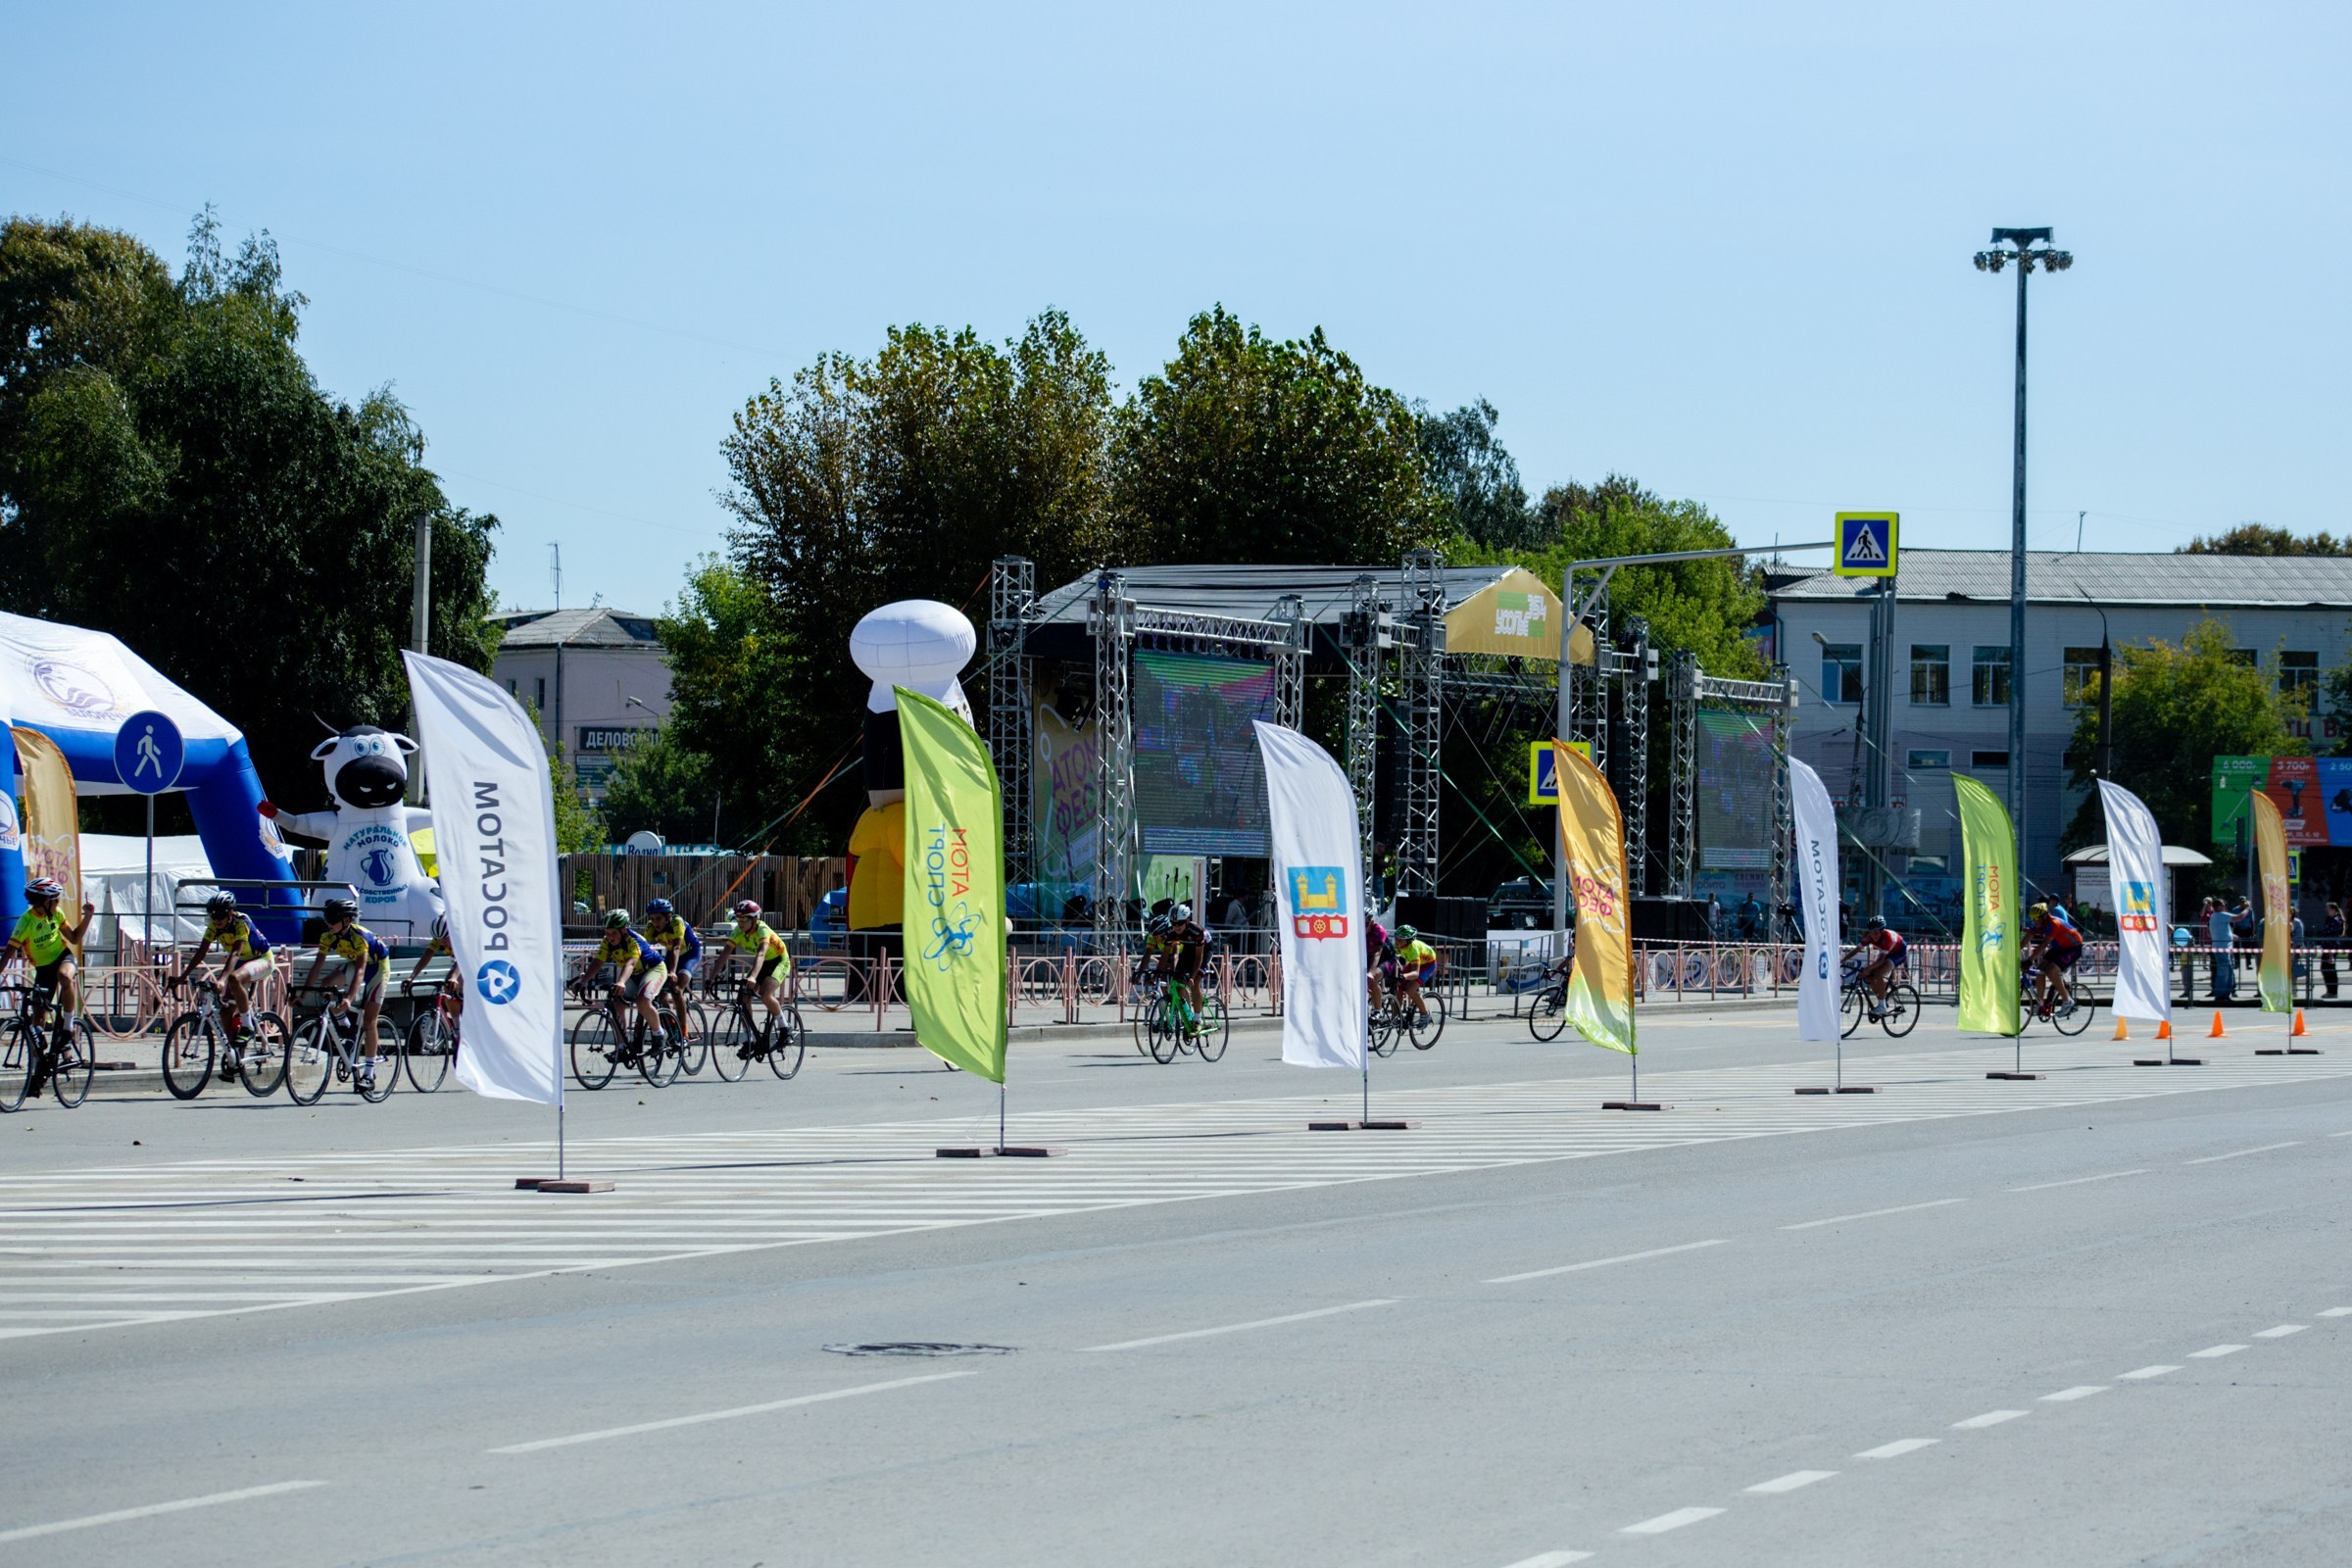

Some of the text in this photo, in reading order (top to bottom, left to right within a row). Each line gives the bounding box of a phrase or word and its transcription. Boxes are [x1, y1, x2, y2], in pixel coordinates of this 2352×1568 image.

[586, 731, 644, 749] ДЕЛОВО
[343, 826, 408, 851] НАТУРАЛЬНОЕ
[357, 835, 399, 848] МОЛОКО
[360, 884, 409, 896] СОБСТВЕННЫХ
[366, 896, 397, 905] КОРОВ
